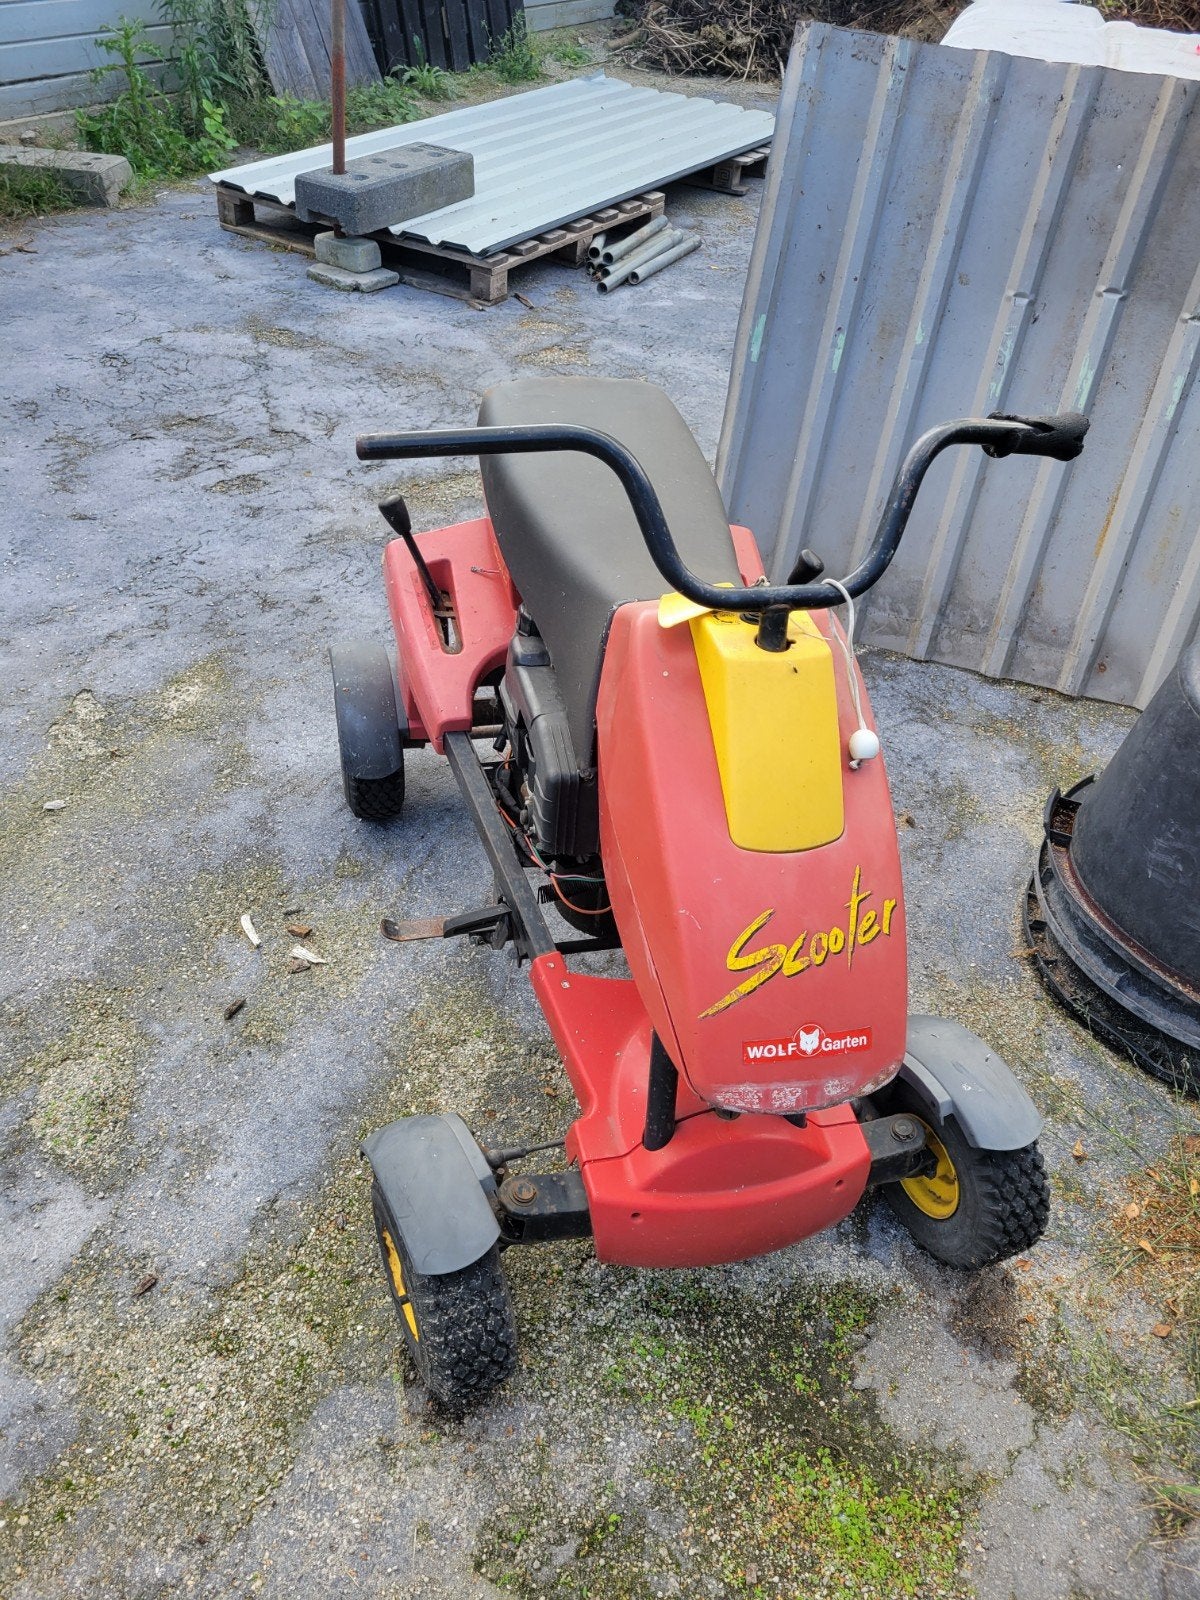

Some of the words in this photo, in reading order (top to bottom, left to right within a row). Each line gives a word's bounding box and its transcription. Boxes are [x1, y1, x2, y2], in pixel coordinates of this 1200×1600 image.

[697, 865, 897, 1019] Scooter
[747, 1042, 797, 1059] WOLF
[821, 1035, 867, 1051] Garten
